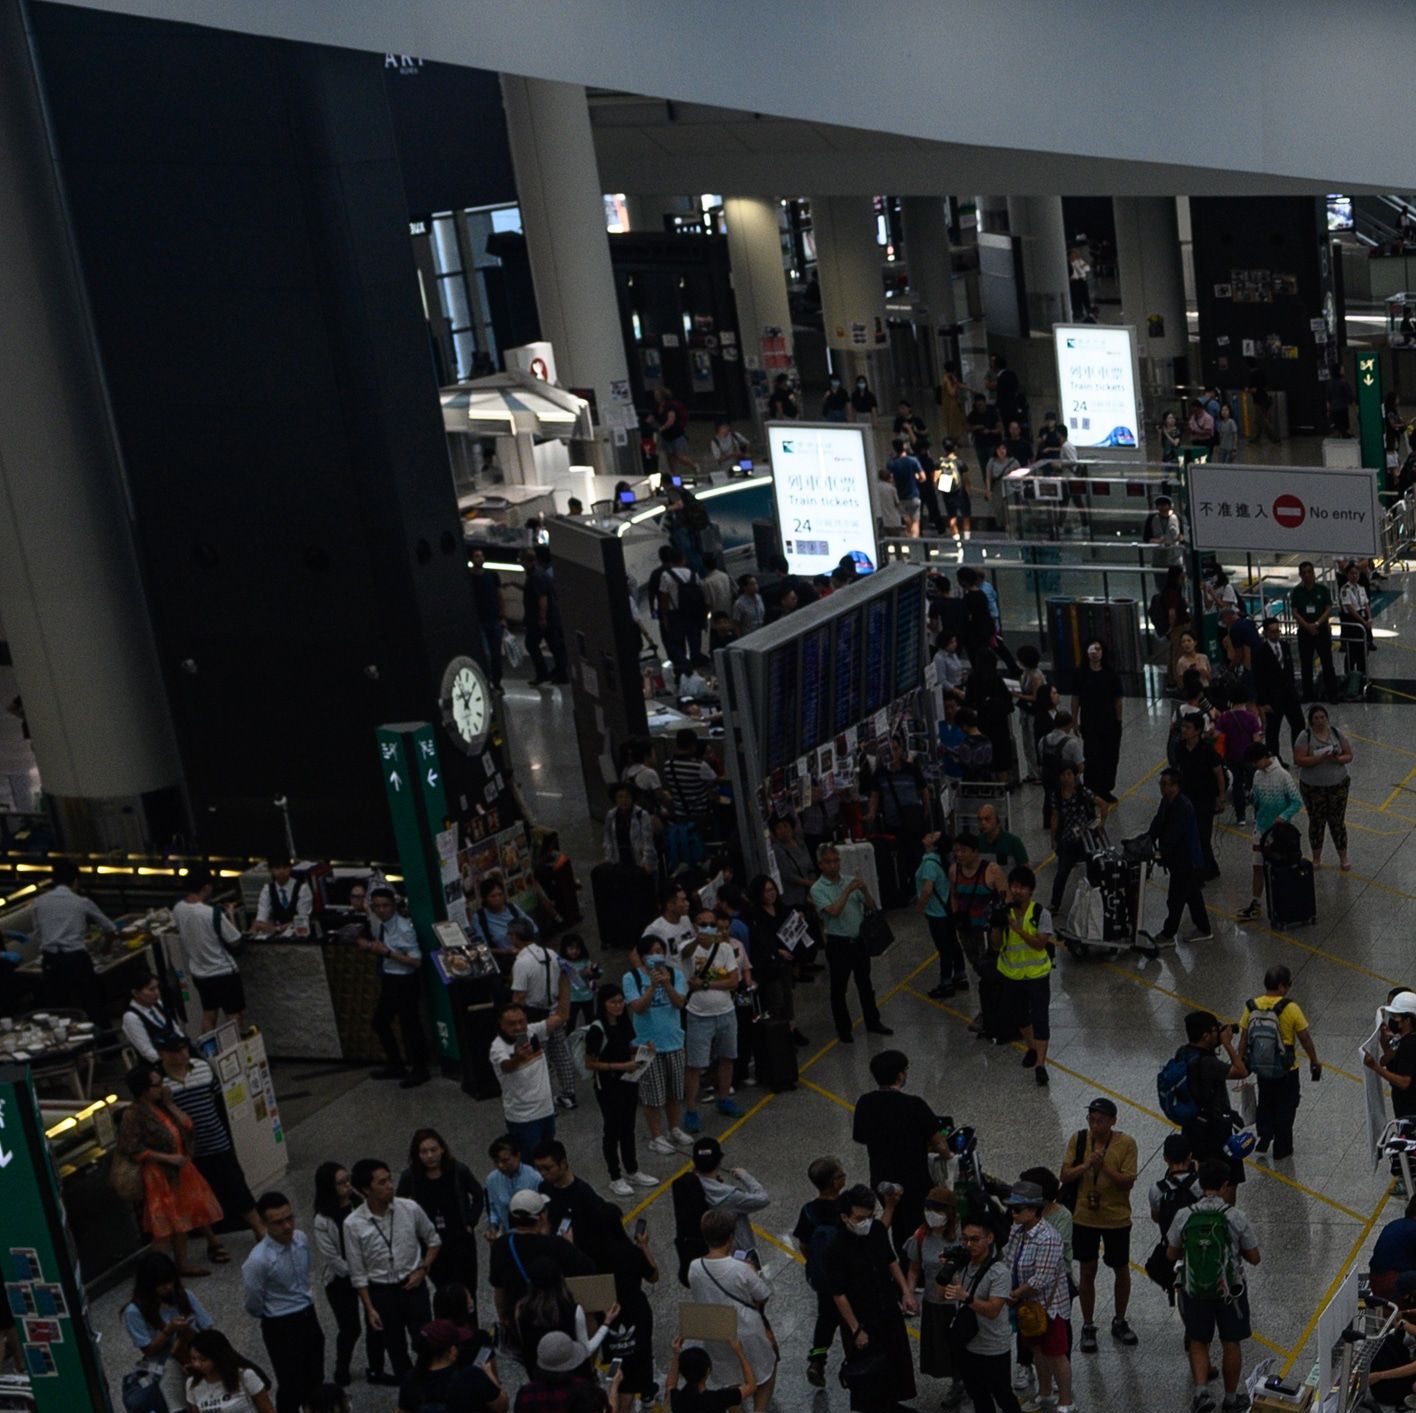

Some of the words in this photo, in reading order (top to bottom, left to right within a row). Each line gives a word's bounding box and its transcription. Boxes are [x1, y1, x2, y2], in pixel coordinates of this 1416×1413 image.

[1073, 400, 1087, 412] 24
[789, 495, 817, 504] Train
[821, 495, 859, 507] tickets
[1200, 501, 1269, 519] 不准進入
[1310, 507, 1328, 520] No
[1332, 508, 1366, 523] entry
[793, 519, 812, 533] 24
